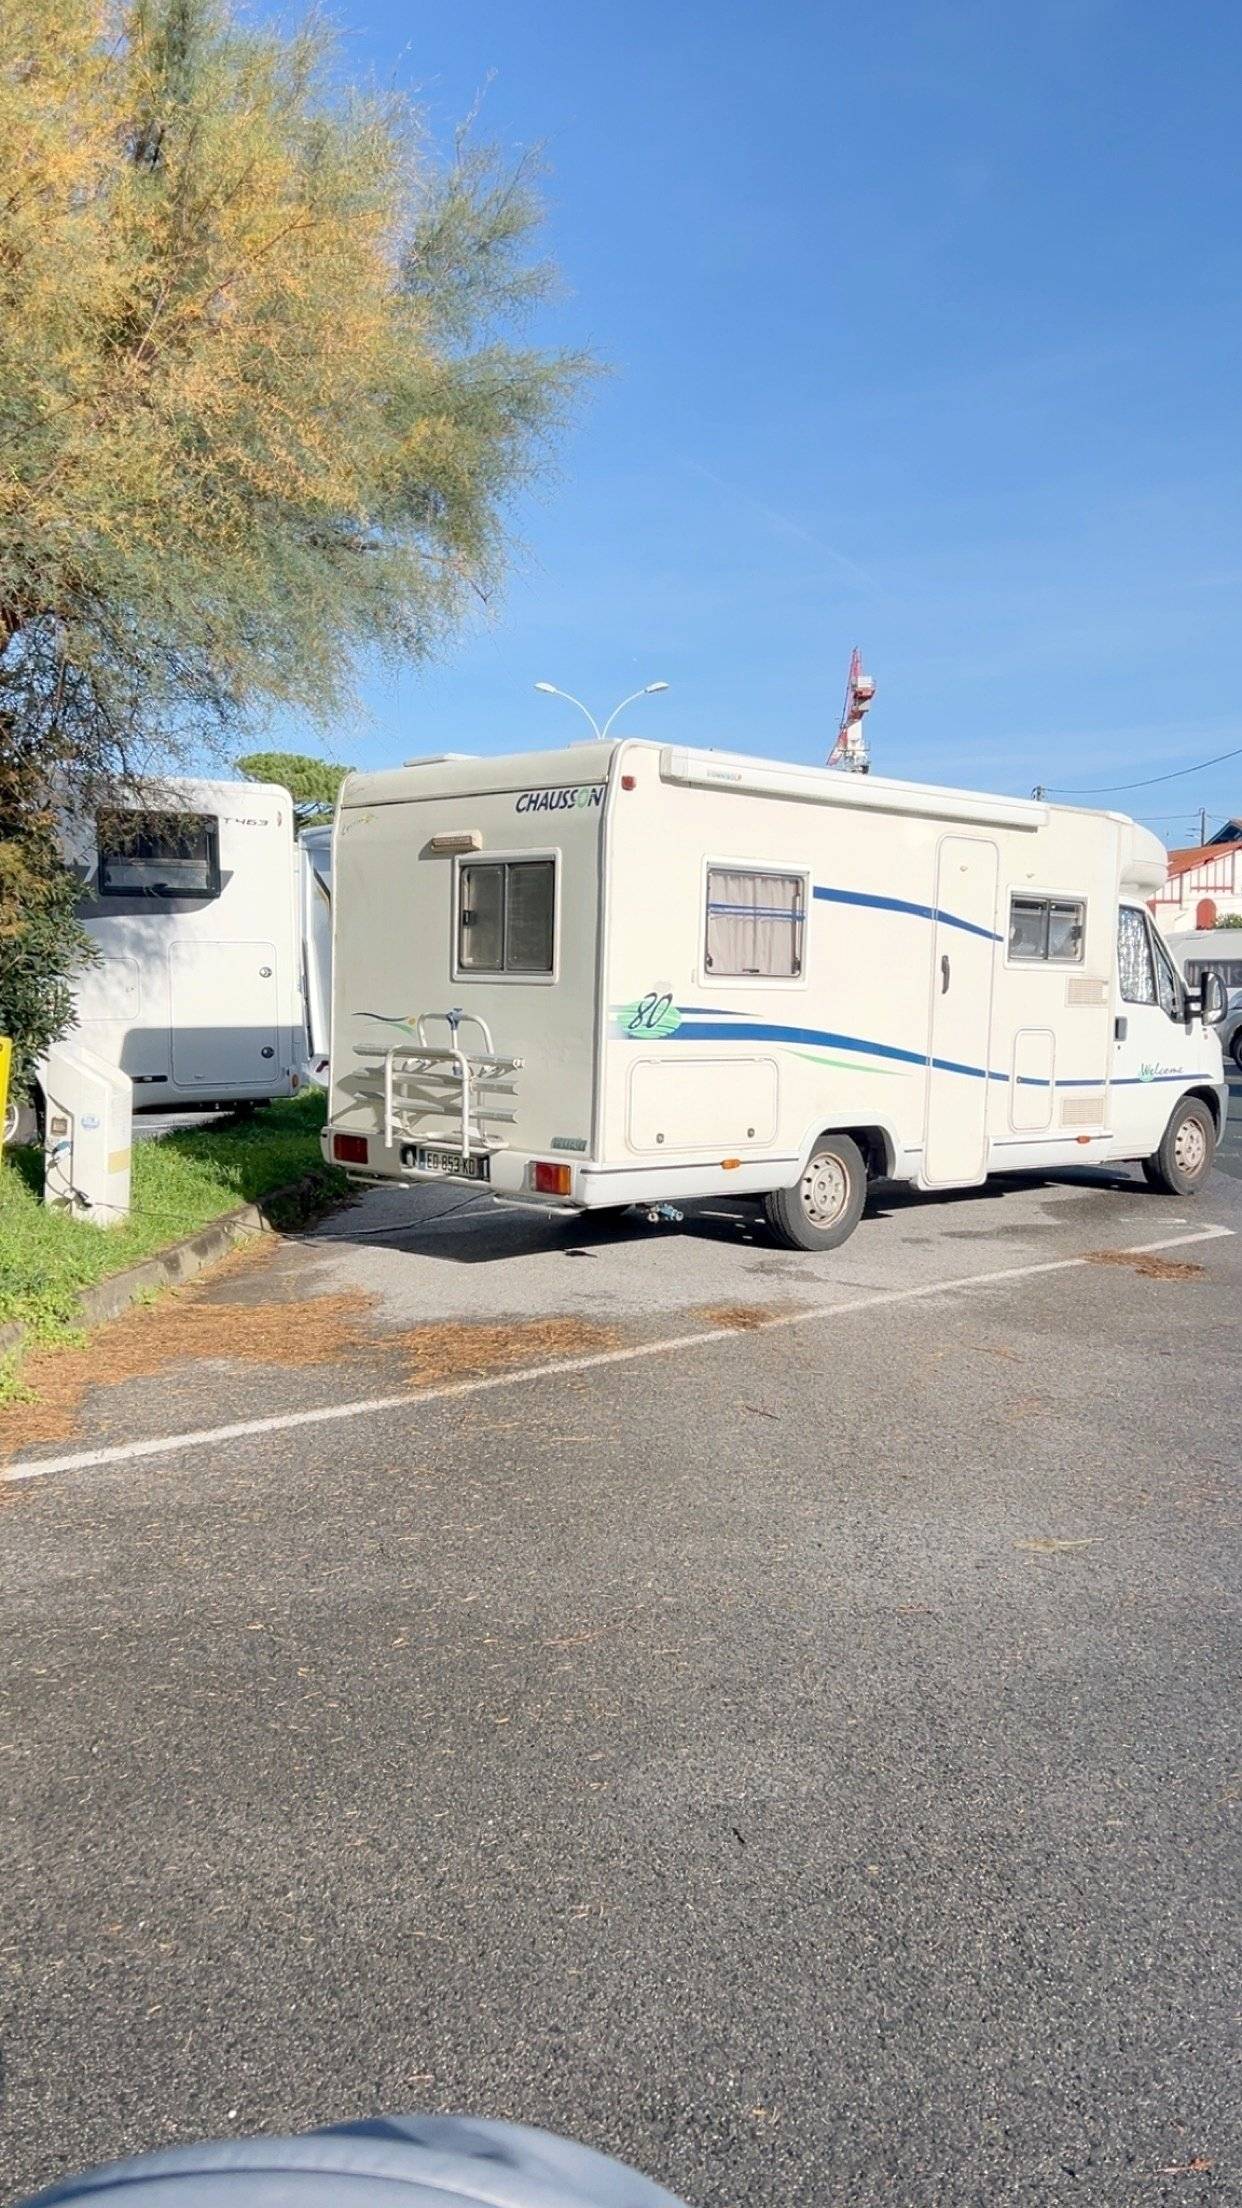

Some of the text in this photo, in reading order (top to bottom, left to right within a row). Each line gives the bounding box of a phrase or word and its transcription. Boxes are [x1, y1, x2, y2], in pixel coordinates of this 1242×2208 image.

[515, 786, 604, 813] CHAUSSON
[628, 992, 673, 1029] 80
[1140, 1062, 1185, 1077] Welcome
